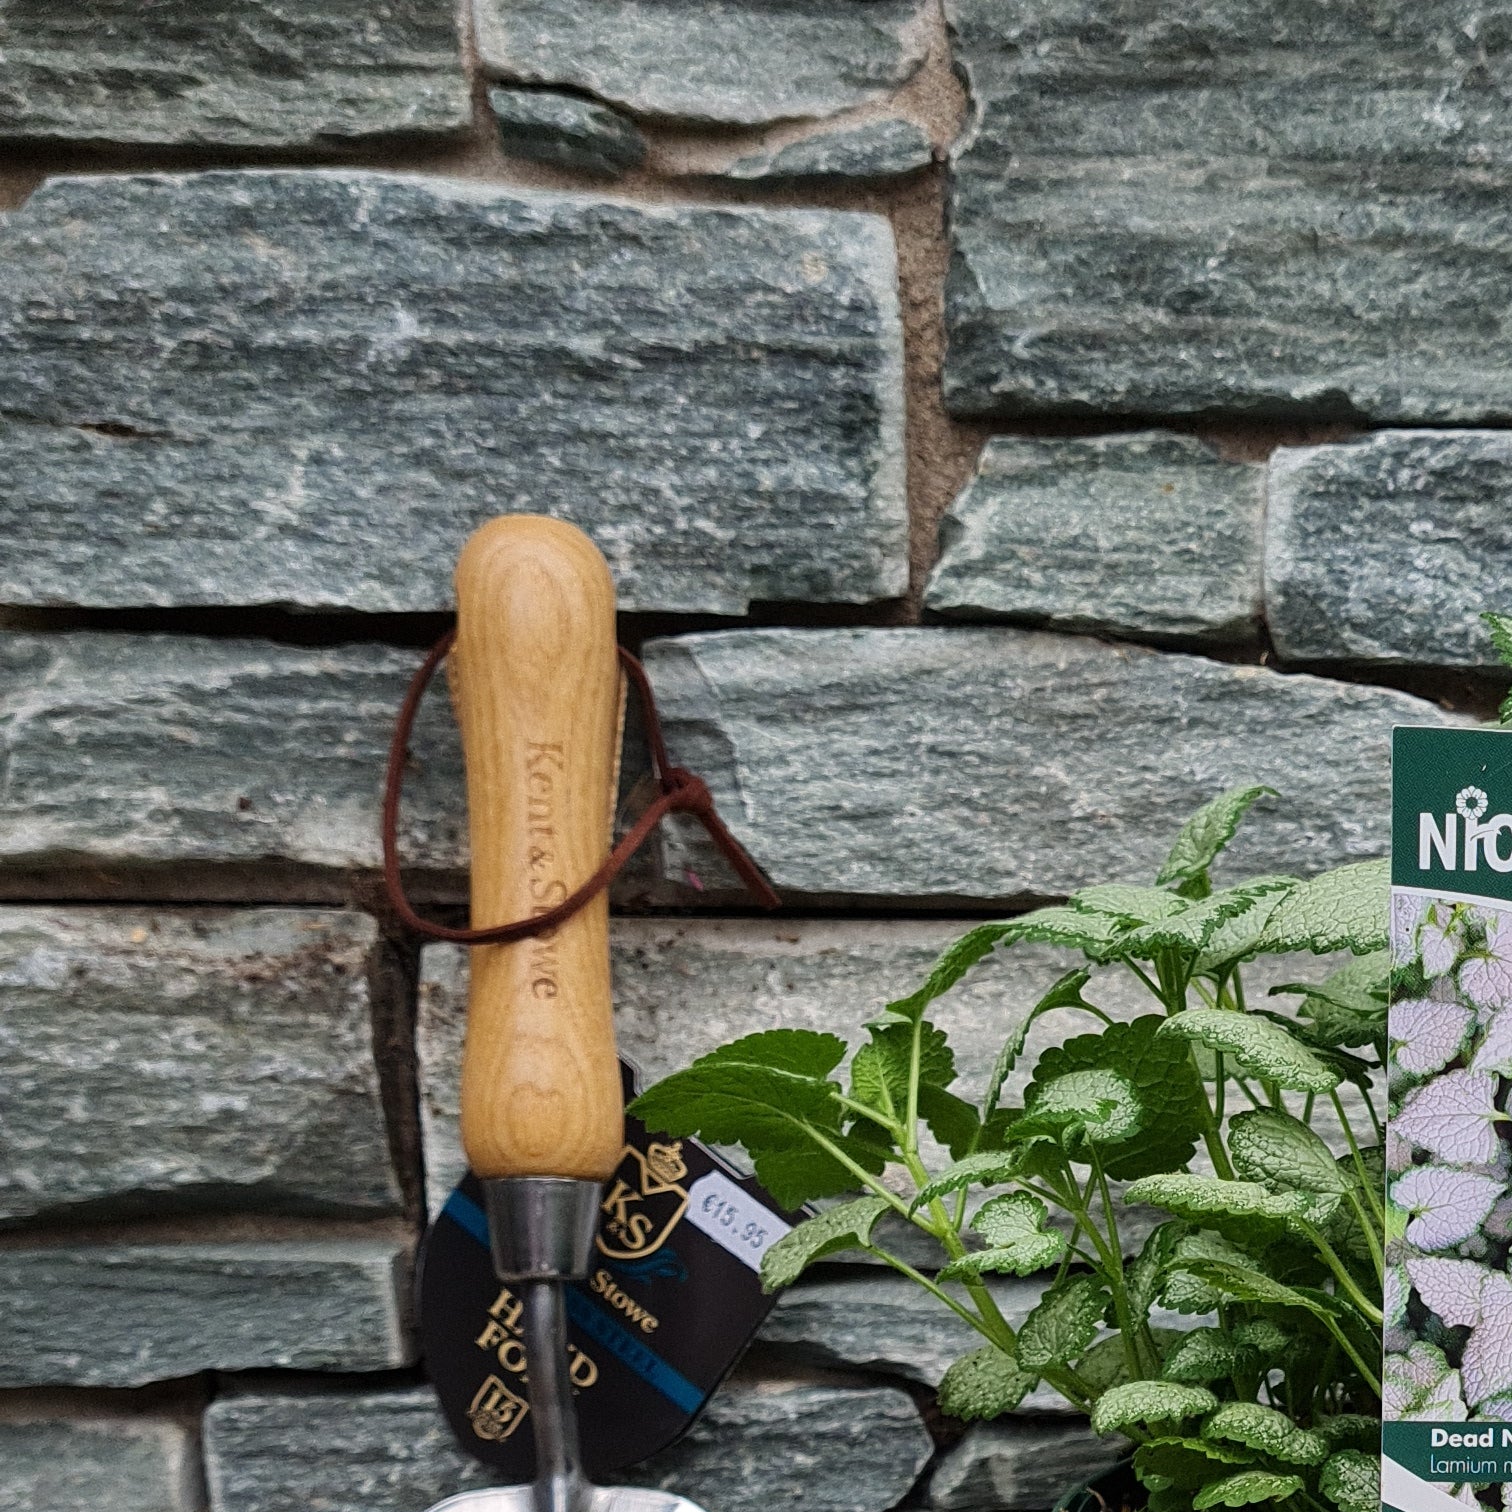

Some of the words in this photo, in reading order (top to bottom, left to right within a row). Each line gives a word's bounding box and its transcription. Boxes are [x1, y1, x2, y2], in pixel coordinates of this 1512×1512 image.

[526, 741, 563, 836] Kent
[702, 1194, 768, 1248] €15.95
[590, 1268, 659, 1333] Stowe
[1430, 1454, 1497, 1474] Lamium
[1431, 1428, 1493, 1448] Dead
